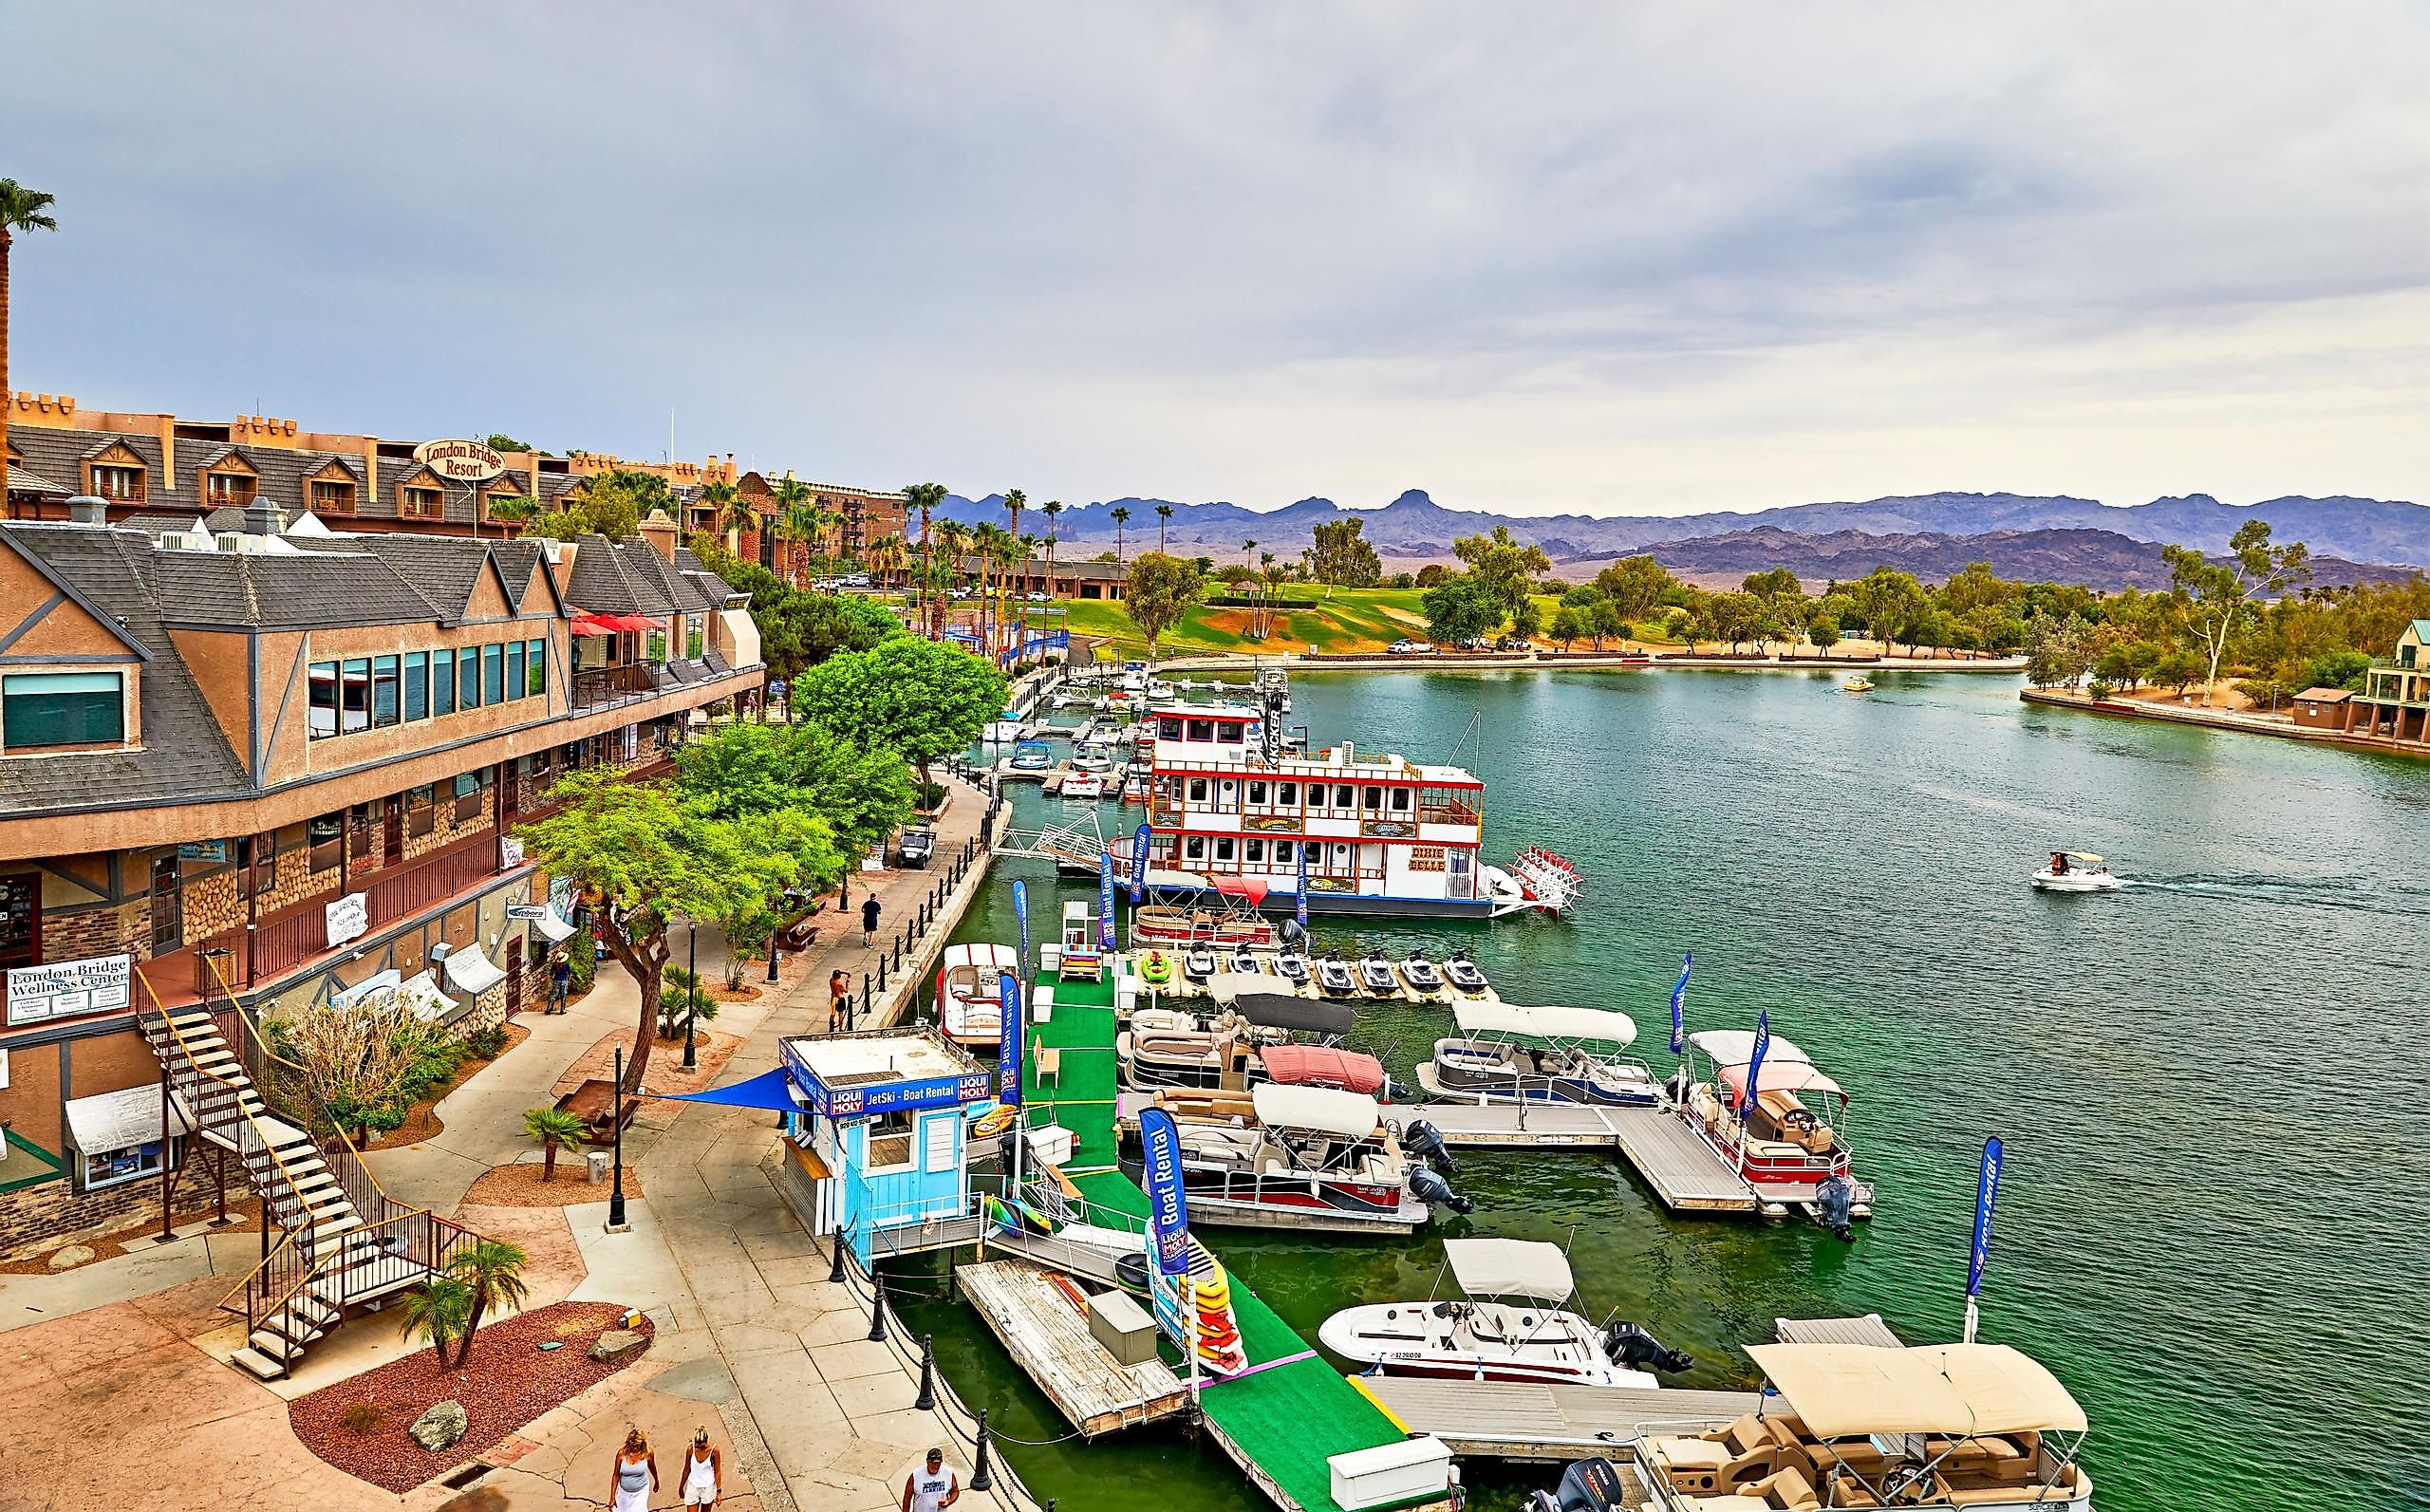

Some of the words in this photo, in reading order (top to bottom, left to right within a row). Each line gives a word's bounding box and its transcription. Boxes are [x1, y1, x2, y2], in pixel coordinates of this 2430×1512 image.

[426, 442, 466, 463] London
[469, 444, 501, 469] Bridge
[445, 459, 482, 476] Resort
[1269, 710, 1280, 759] KICKER
[1411, 848, 1444, 858] DIXIE
[1409, 859, 1445, 871] BELLE
[1103, 865, 1112, 895] Rental
[1103, 896, 1112, 919] Boat
[11, 969, 72, 985] London
[77, 961, 125, 975] Bridge
[11, 980, 78, 996] Wellness
[81, 974, 126, 987] Center
[959, 1076, 986, 1088] LIQUI
[832, 1092, 862, 1104] LIQUI
[868, 1092, 895, 1105] JetSki
[904, 1088, 924, 1101] Boat
[926, 1084, 954, 1098] Rental
[959, 1086, 987, 1099] MOLY
[832, 1101, 862, 1113] MOLY
[1150, 1126, 1174, 1184] Rental
[1158, 1184, 1179, 1226] Boat
[1163, 1226, 1185, 1243] LIQUI
[1164, 1236, 1187, 1253] MOLY
